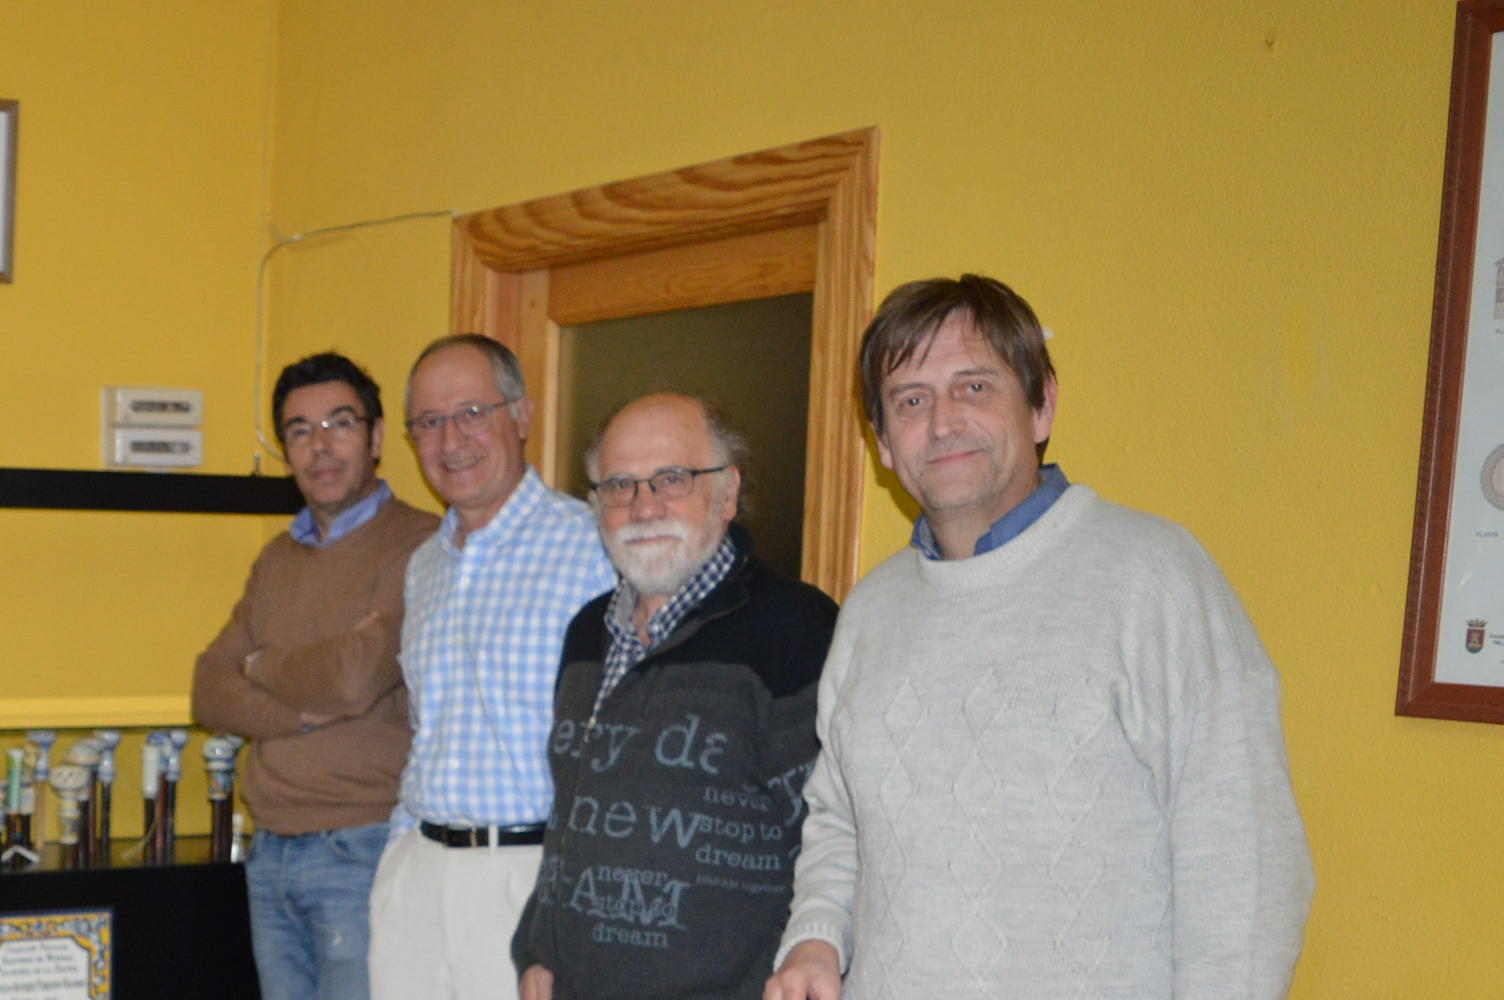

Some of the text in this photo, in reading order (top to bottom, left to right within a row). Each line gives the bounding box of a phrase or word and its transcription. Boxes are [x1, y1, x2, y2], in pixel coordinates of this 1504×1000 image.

[567, 794, 706, 849] new
[699, 815, 755, 843] stop
[694, 844, 781, 871] dream
[592, 921, 669, 947] dream
